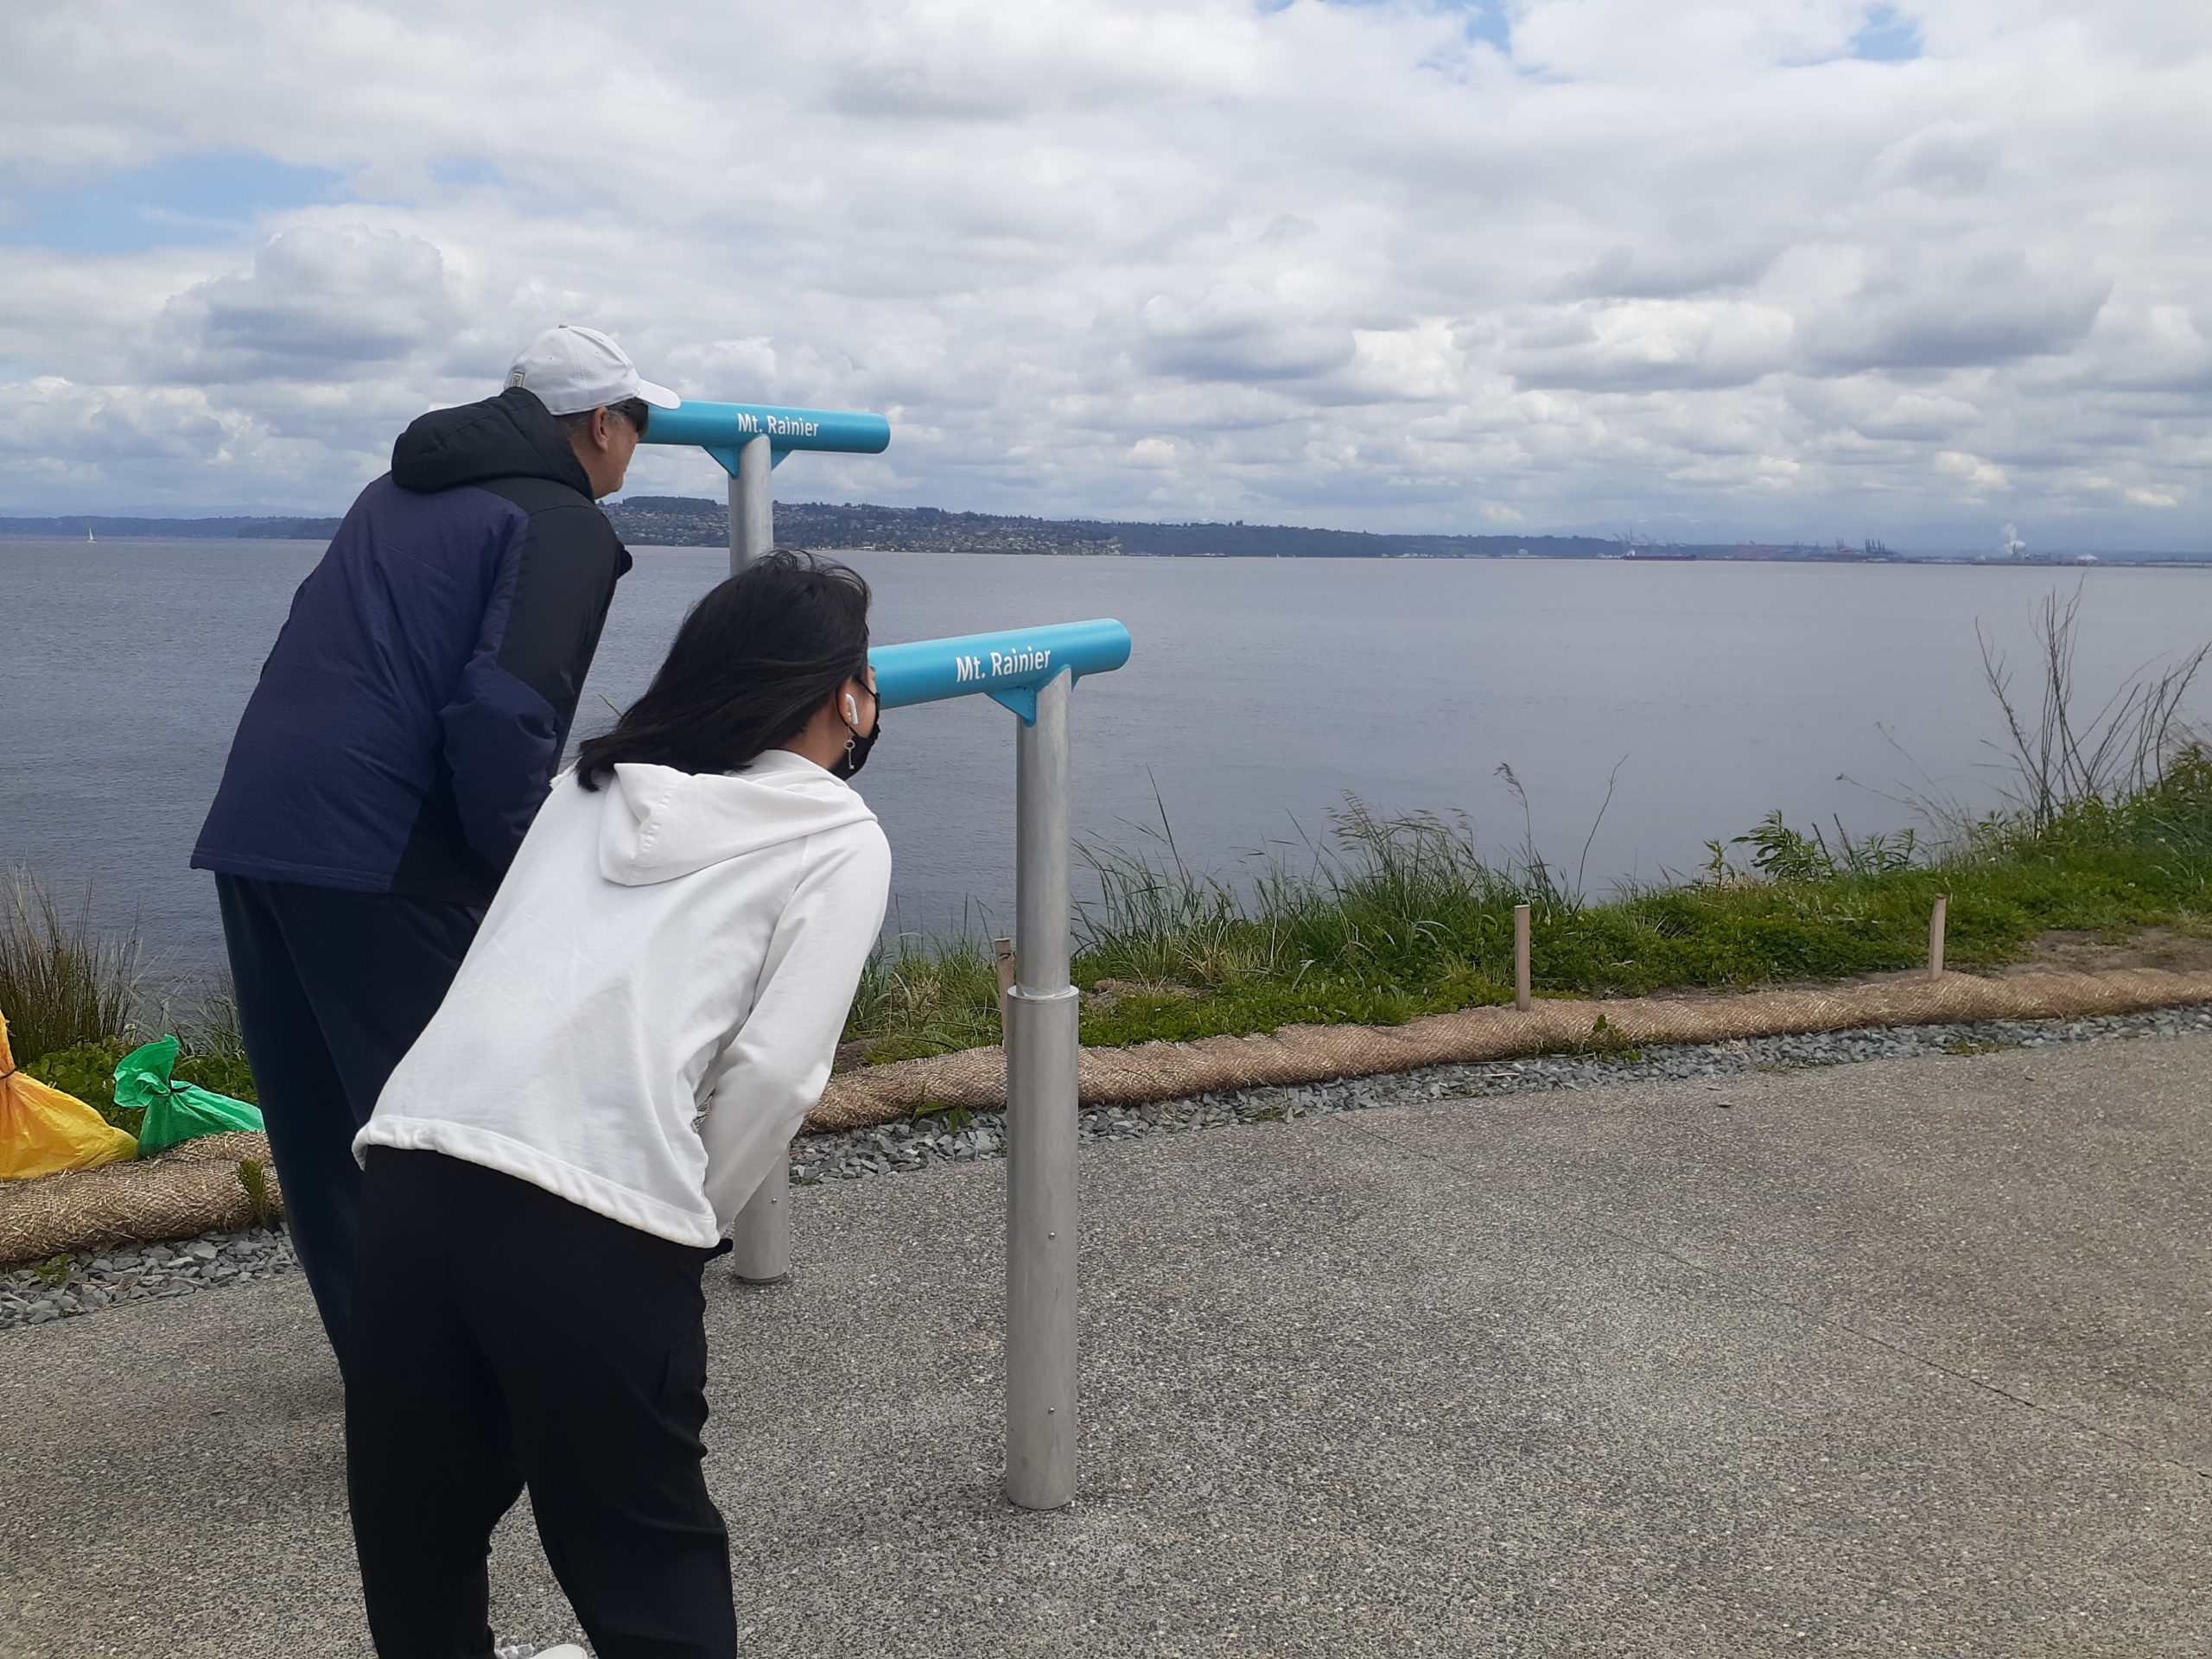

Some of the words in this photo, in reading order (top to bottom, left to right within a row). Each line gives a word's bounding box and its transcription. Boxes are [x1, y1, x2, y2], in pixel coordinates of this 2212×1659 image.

[737, 413, 763, 433] Mt.
[766, 415, 819, 436] Rainier
[956, 656, 986, 683] Mt.
[990, 645, 1051, 677] Rainier
